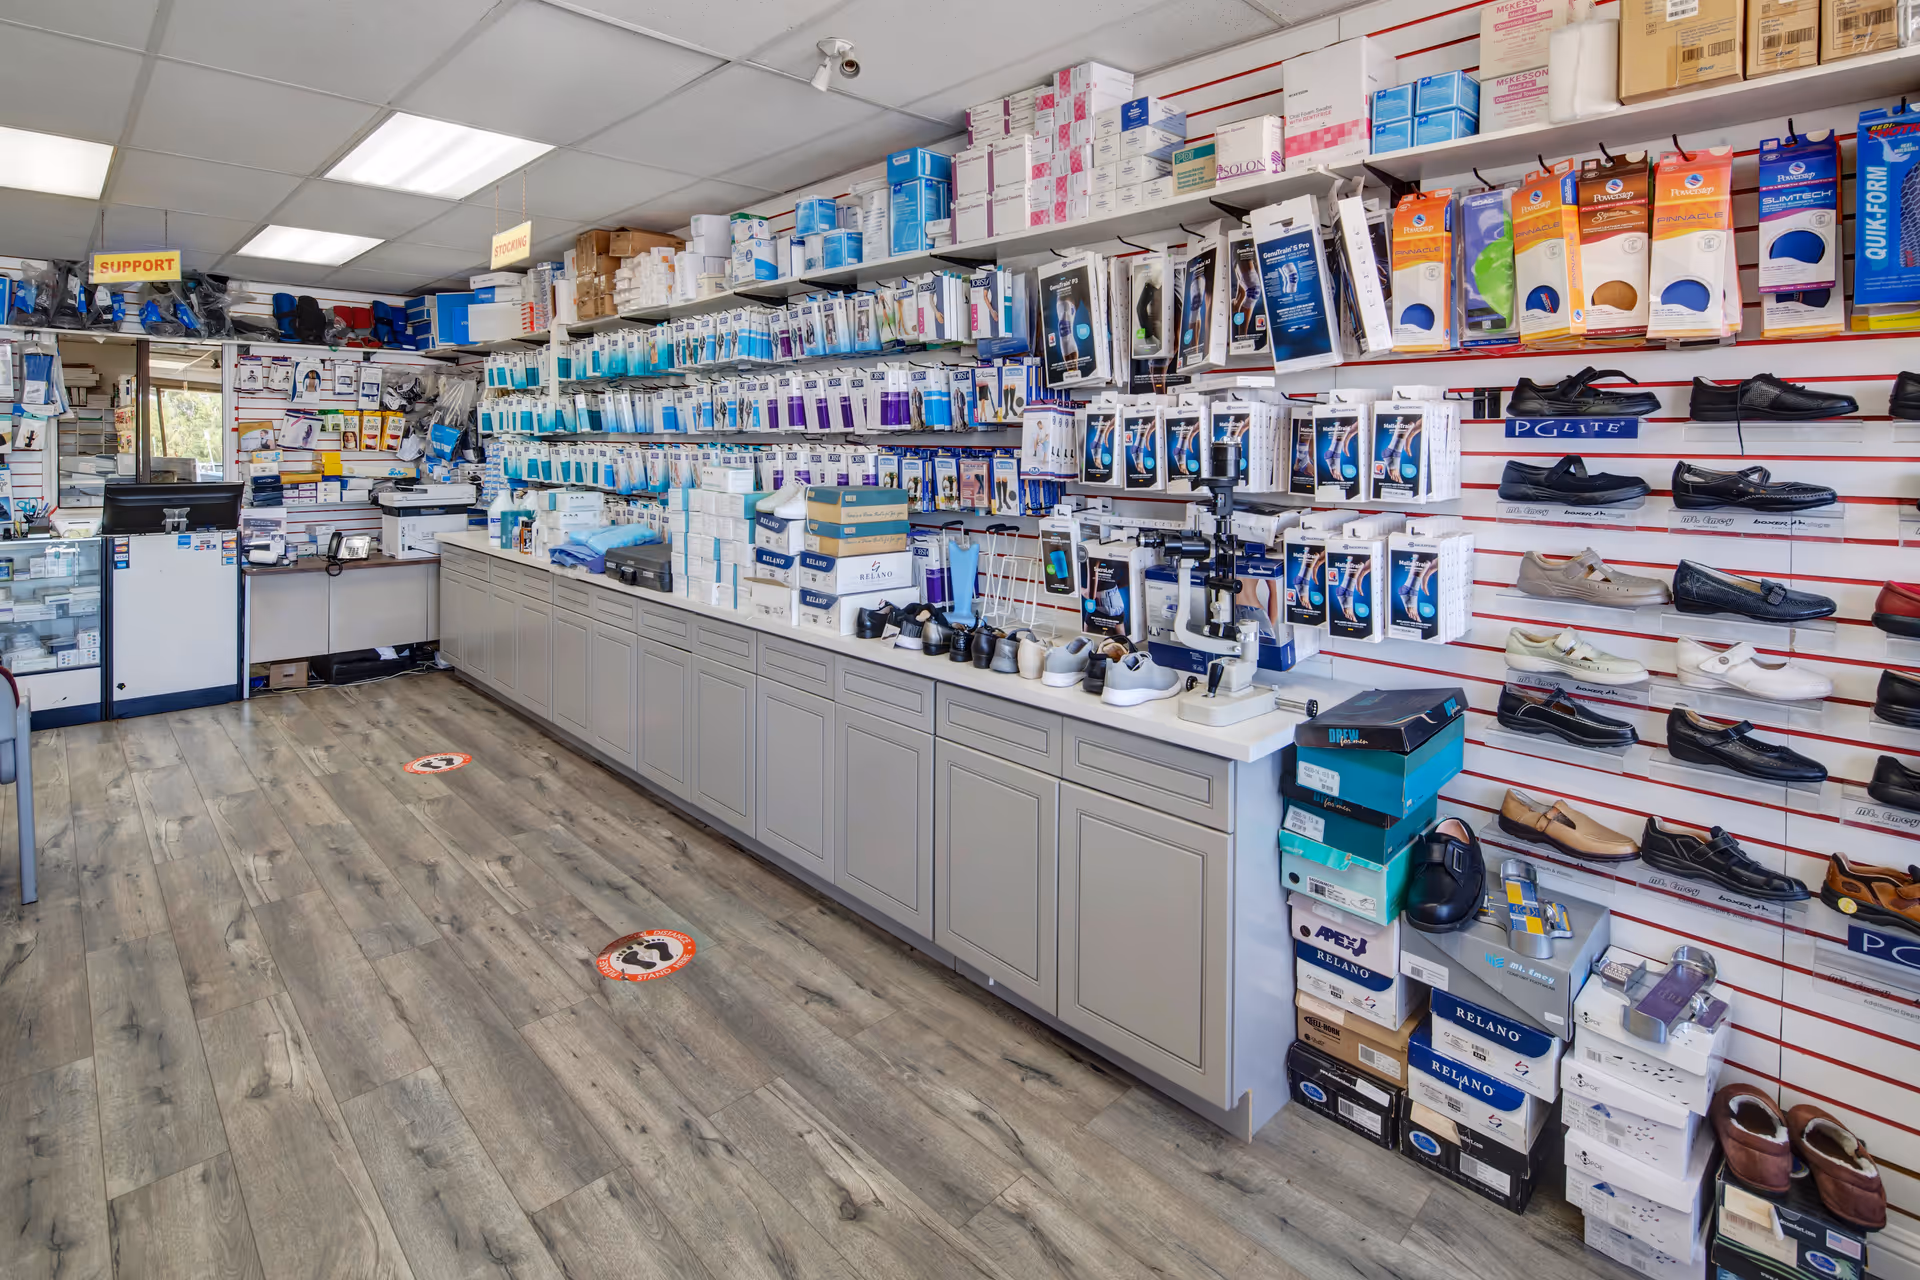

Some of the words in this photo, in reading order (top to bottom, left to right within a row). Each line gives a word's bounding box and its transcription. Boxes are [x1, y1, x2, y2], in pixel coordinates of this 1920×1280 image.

[1496, 69, 1548, 87] McKESSON
[1175, 150, 1194, 164] PDI
[1223, 158, 1266, 177] SOLON
[1777, 172, 1816, 182] Powerstep
[1593, 191, 1634, 203] Powerstep
[1670, 187, 1715, 197] Powerstep
[1762, 190, 1831, 205] SLIMTECH
[1521, 200, 1551, 215] Powerstep
[1865, 166, 1888, 260] QUIK-FORM
[1656, 212, 1724, 224] PINNACLE
[1403, 225, 1434, 235] Powerstep
[1515, 221, 1560, 239] PINNACLE
[494, 234, 528, 258] STOCKING
[1263, 245, 1292, 259] GenuTrain
[1298, 242, 1310, 251] Pro
[1394, 246, 1441, 256] PINNACLE
[99, 257, 176, 275] SUPPORT
[1049, 279, 1071, 291] GenuTrain
[760, 516, 779, 529] RELANO
[762, 555, 785, 565] RELANO
[806, 558, 827, 568] RELANO
[859, 570, 893, 581] RELANO
[806, 595, 827, 605] RELANO
[1329, 728, 1359, 743] DREW
[1340, 735, 1353, 746] for
[1324, 798, 1335, 809] for
[1336, 802, 1352, 812] men
[1882, 811, 1920, 828] Emey
[653, 930, 692, 944] DISTANCE
[1314, 925, 1359, 951] APEX
[673, 953, 693, 968] HERE
[1316, 950, 1370, 979] RELANO
[636, 968, 672, 981] STAND
[1507, 970, 1529, 981] COMFORT
[1529, 979, 1556, 991] FOOTWEAR
[1528, 968, 1556, 985] Emey
[1456, 1006, 1519, 1042] RELANO
[1431, 1060, 1493, 1096] RELANO
